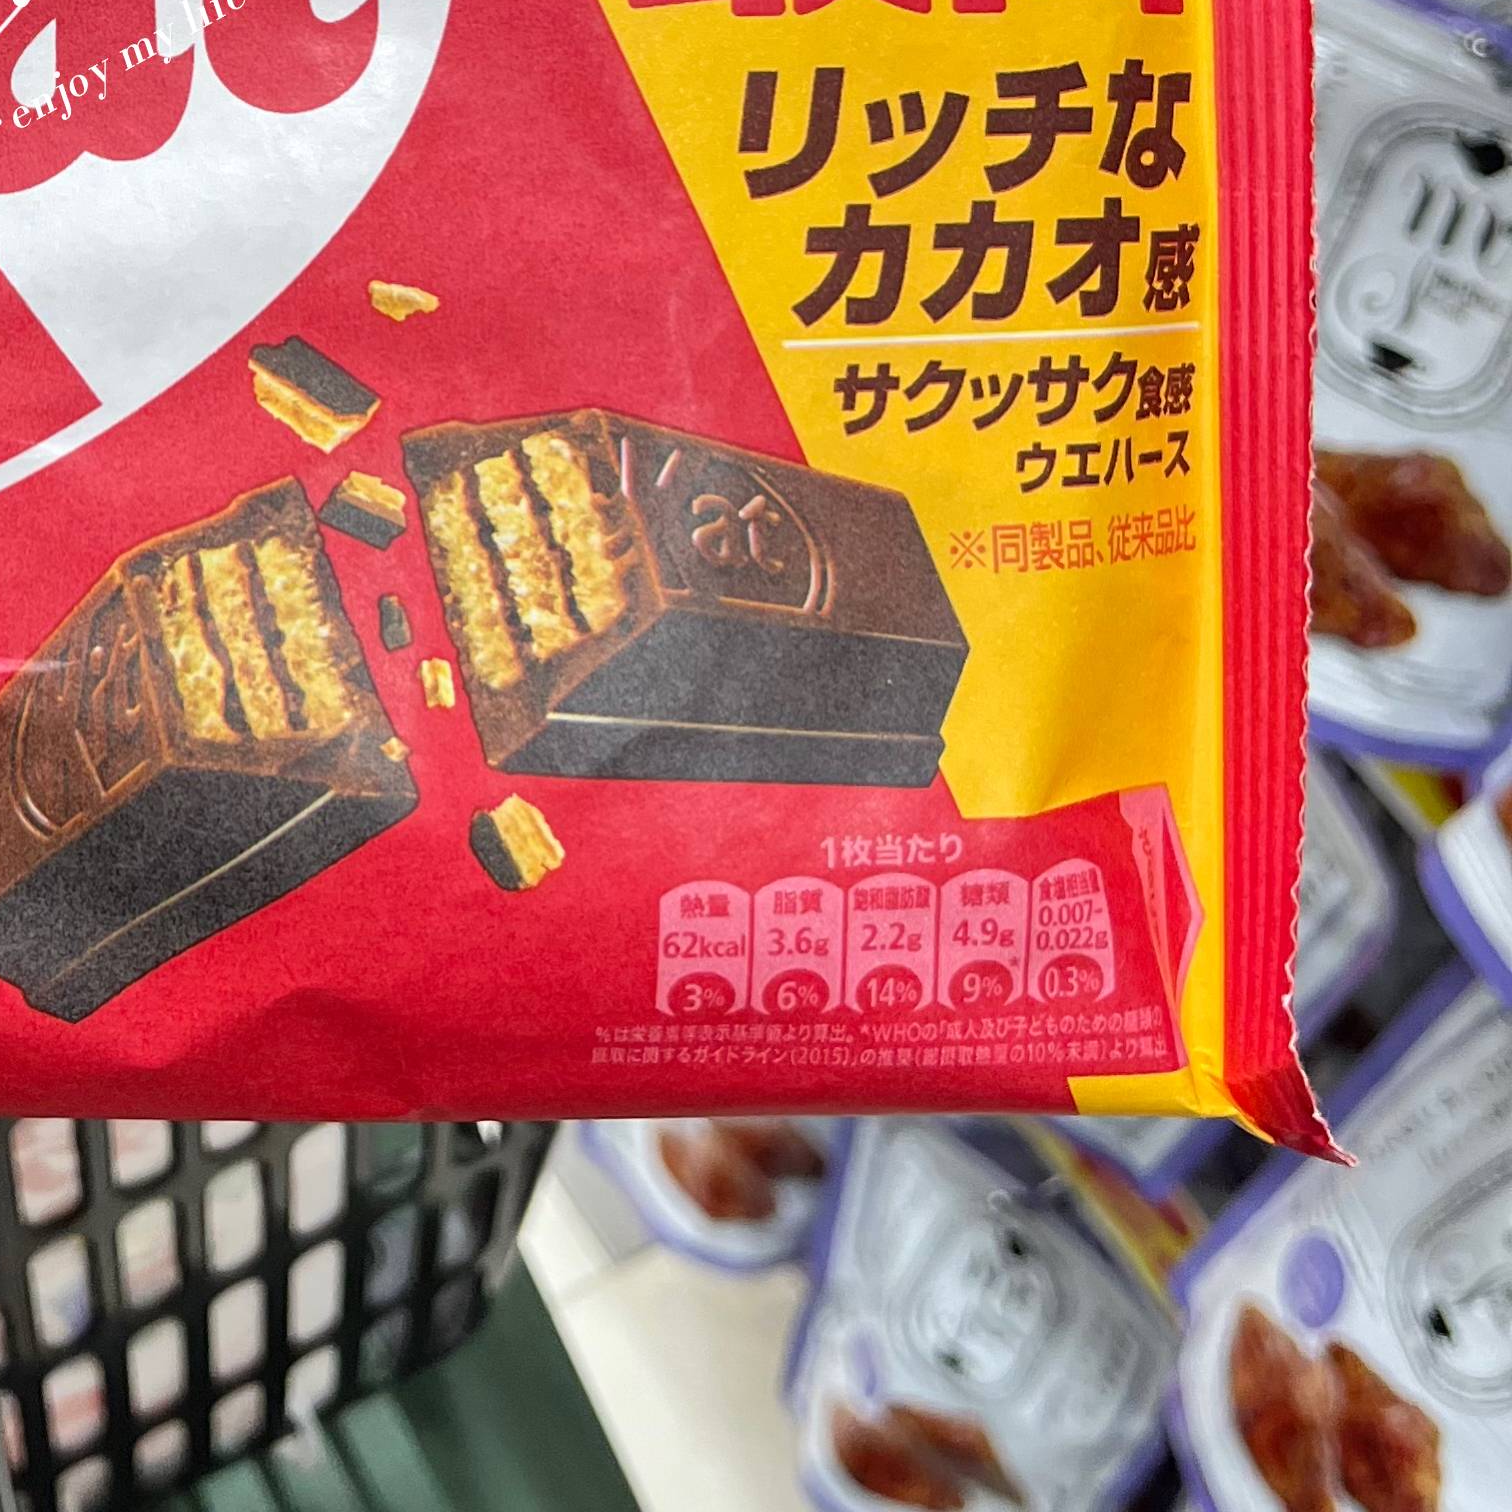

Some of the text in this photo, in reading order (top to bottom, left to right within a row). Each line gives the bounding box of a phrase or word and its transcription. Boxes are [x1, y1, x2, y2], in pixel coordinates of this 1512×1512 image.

[738, 58, 1192, 201] リッチな
[791, 197, 1201, 328] カカオ感
[833, 351, 1196, 437] サクッサク食感
[1015, 430, 1191, 494] ウエハース
[820, 833, 964, 870] 1枚当たり
[662, 917, 1015, 959] 62kcal 3.6g 2.2g 4.9g
[1036, 926, 1108, 951] 0.022g
[682, 983, 726, 1011] 3%
[777, 980, 819, 1011] 6%
[866, 977, 918, 1008] 14%
[1044, 965, 1101, 999] 0.3%
